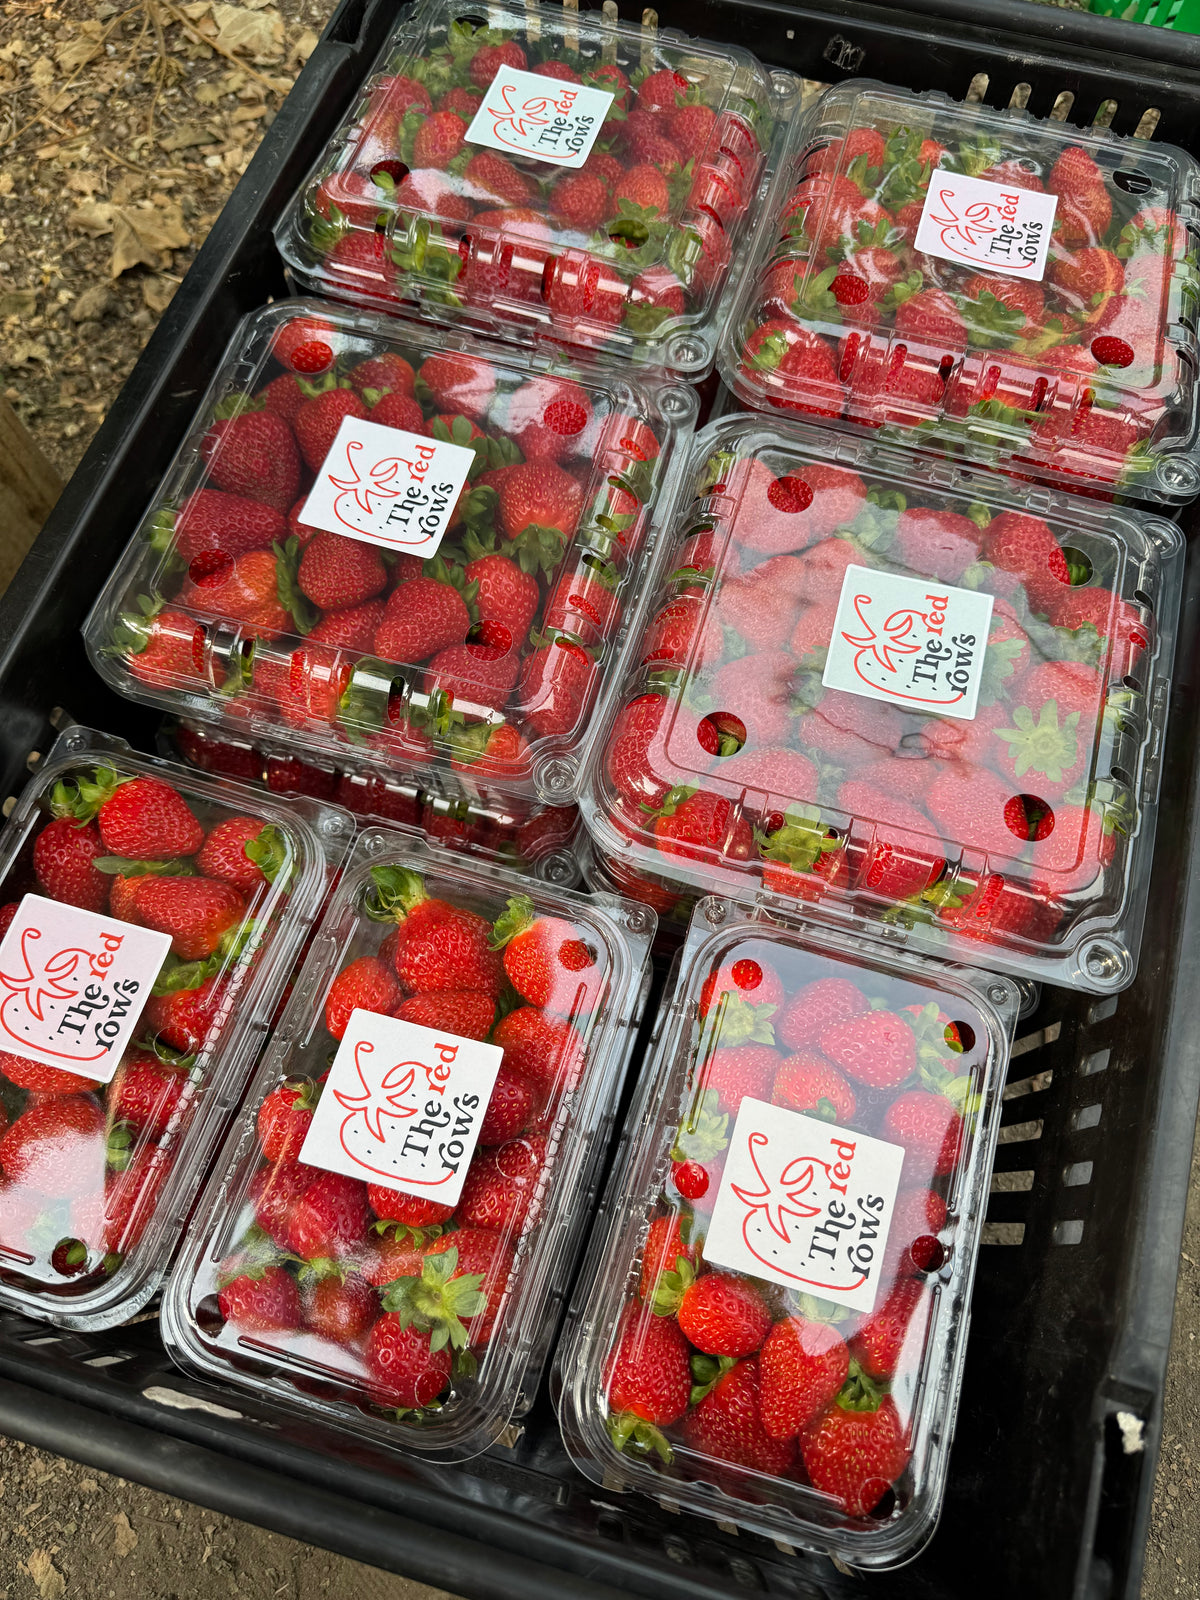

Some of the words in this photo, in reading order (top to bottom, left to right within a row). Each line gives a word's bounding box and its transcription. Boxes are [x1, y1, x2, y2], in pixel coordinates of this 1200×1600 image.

[538, 117, 574, 145] The
[554, 90, 578, 116] red
[565, 116, 595, 154] rows
[997, 193, 1020, 223] red
[989, 224, 1023, 254] The
[1018, 221, 1043, 264] rows
[386, 486, 429, 525] The
[408, 444, 436, 484] red
[418, 482, 454, 538] rows
[921, 594, 949, 637] red
[912, 639, 952, 683] The
[945, 633, 976, 696] rows
[56, 984, 110, 1035] The
[89, 932, 125, 981] red
[94, 979, 140, 1052] rows
[400, 1100, 451, 1157] The
[426, 1042, 459, 1096] red
[438, 1093, 480, 1174] rows
[825, 1138, 856, 1196] red
[808, 1200, 856, 1260] The
[847, 1194, 884, 1280] rows
